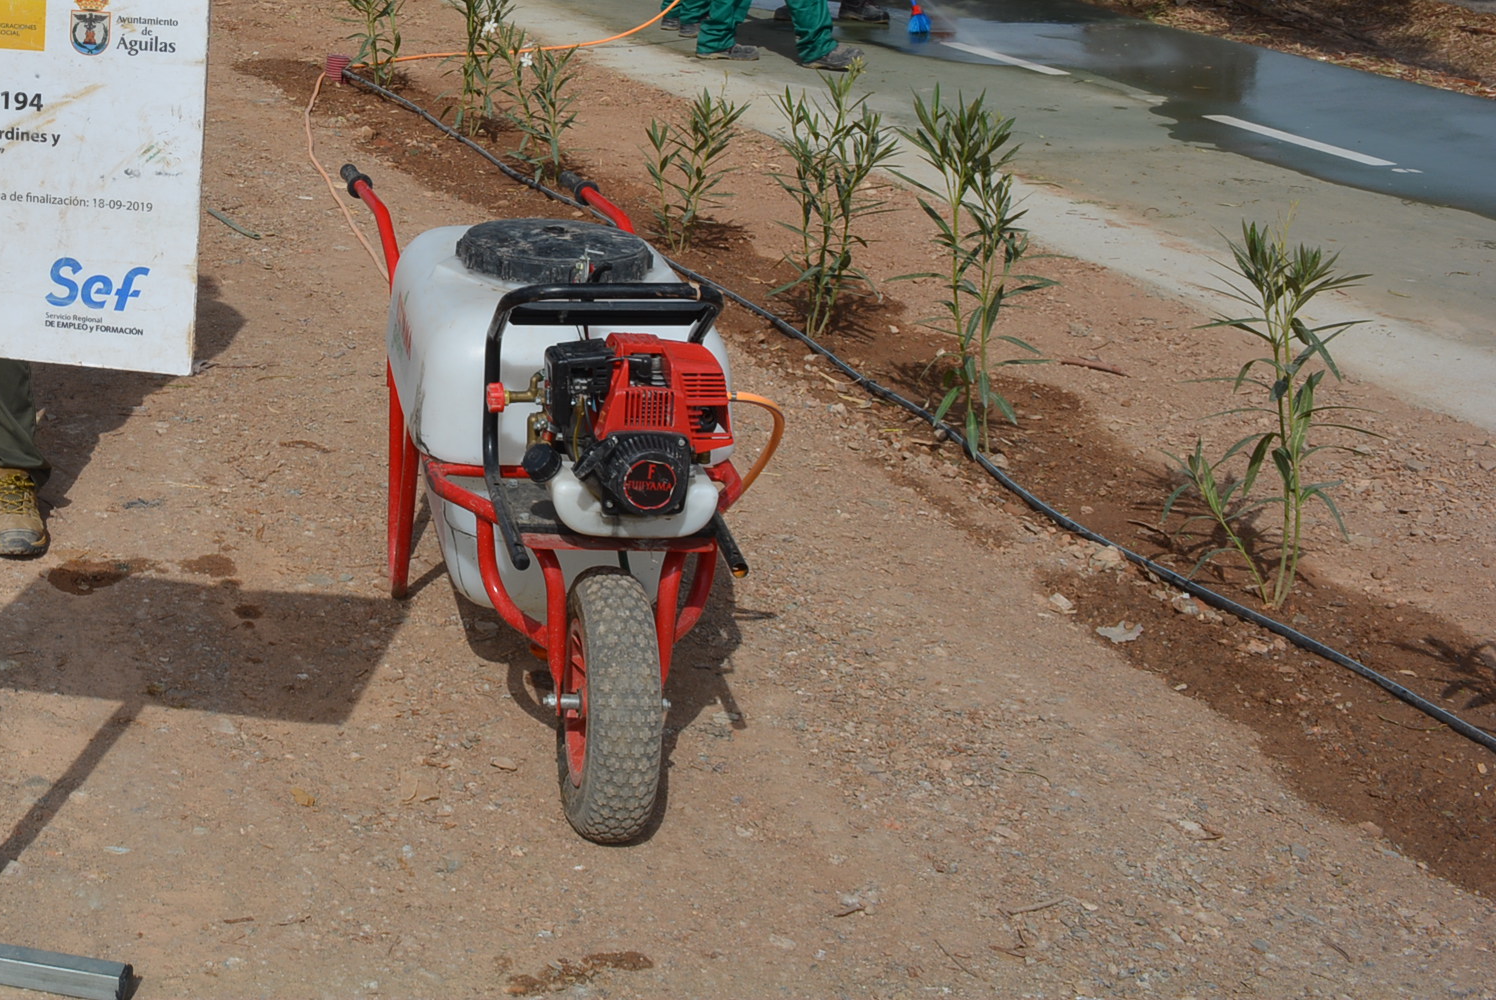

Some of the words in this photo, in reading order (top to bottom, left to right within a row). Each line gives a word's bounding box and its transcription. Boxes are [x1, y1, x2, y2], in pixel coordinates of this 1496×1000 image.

[116, 15, 179, 27] Ayuntamiento
[141, 27, 153, 36] de
[116, 34, 176, 56] Águilas
[51, 132, 61, 147] y
[9, 191, 23, 202] de
[25, 192, 90, 208] finalización:
[93, 198, 153, 212] 18-09-2019
[45, 256, 151, 312] Sef
[45, 311, 71, 321] Servicio
[72, 314, 103, 324] Regional
[44, 319, 56, 328] DE
[56, 320, 88, 331] EMPLEO
[89, 325, 95, 334] y
[95, 324, 144, 336] FORMACIÓN
[647, 463, 657, 480] F
